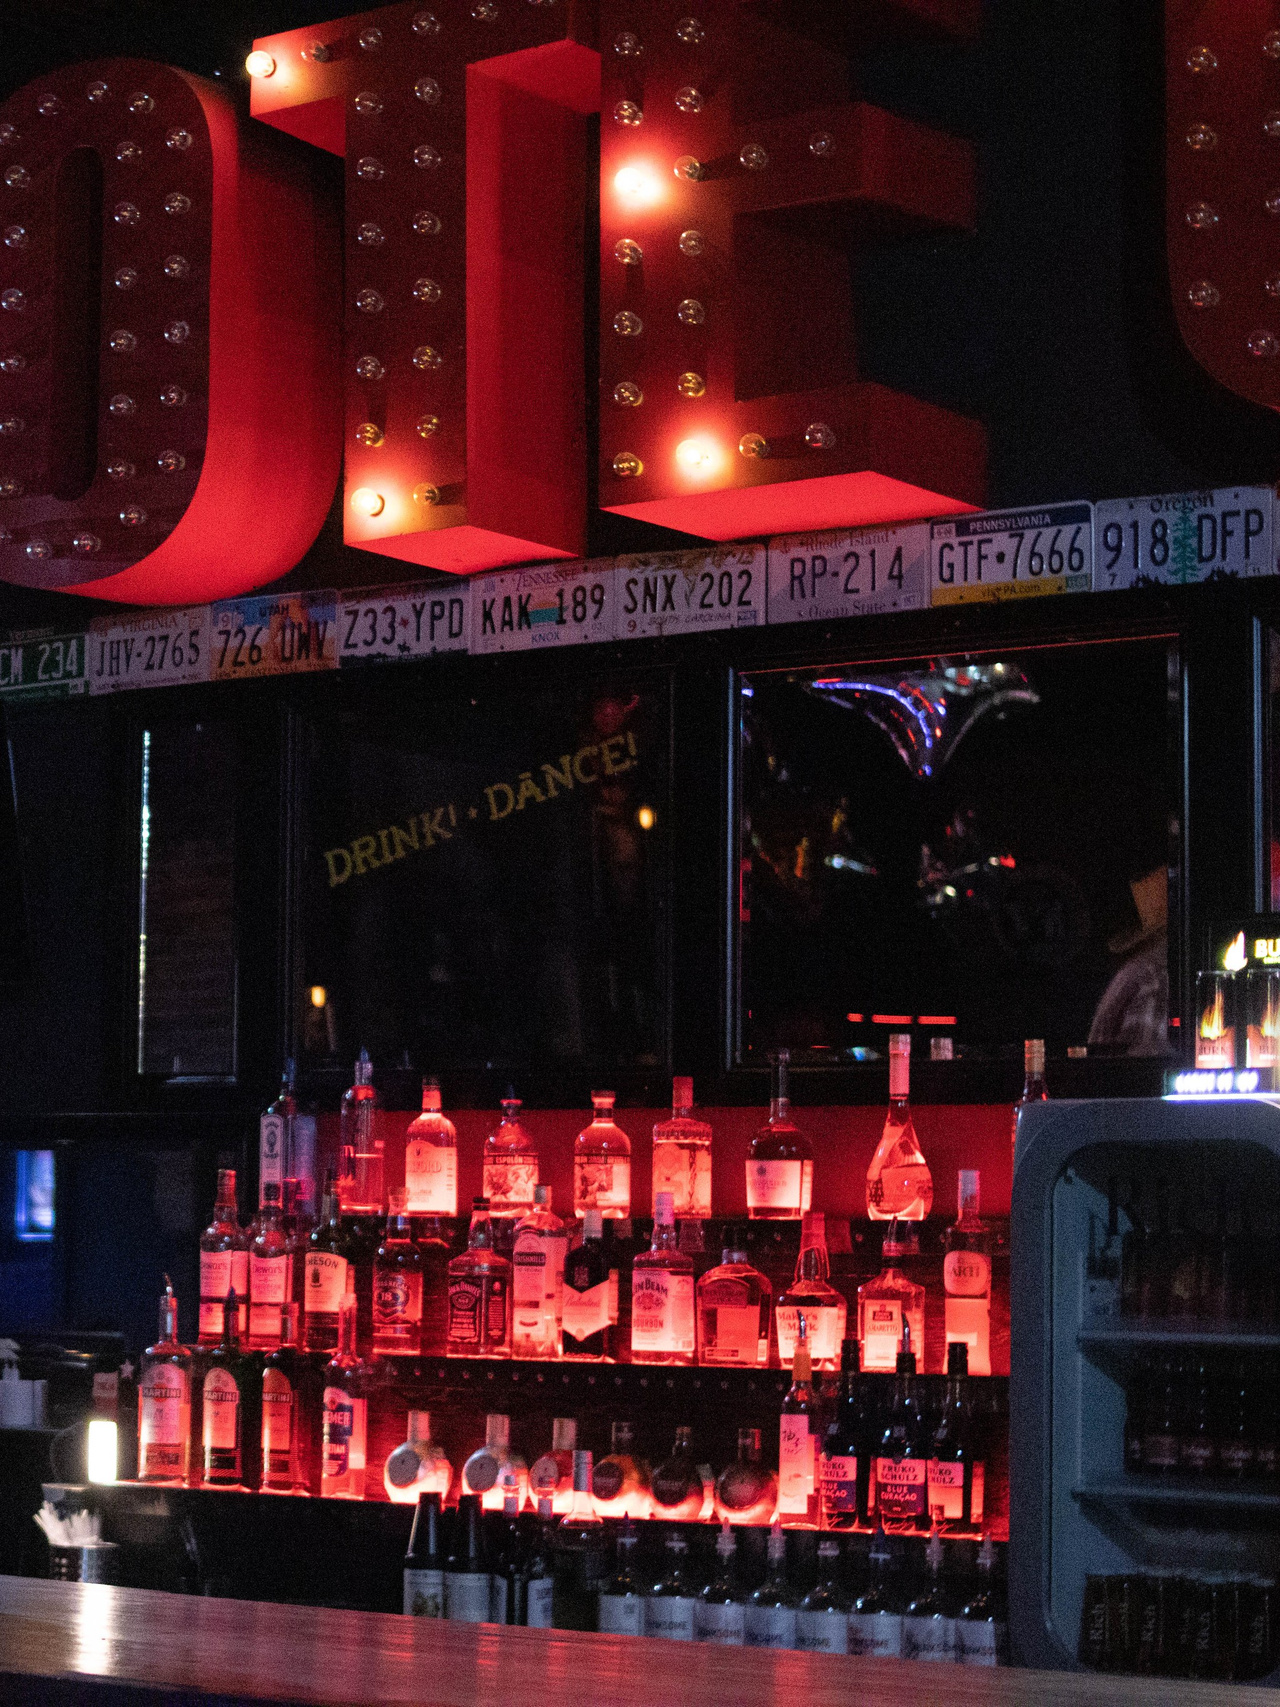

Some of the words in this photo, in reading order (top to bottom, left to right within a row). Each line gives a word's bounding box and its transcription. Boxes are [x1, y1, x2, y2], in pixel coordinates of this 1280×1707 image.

[850, 530, 889, 547] Island
[970, 513, 1051, 532] PENNSYLVANIA
[1103, 518, 1169, 570] 918
[1197, 509, 1264, 563] DFP
[624, 574, 676, 614] SNX
[700, 569, 751, 609] 202
[790, 546, 903, 600] RP-214
[121, 615, 178, 633] VIRGINIA
[482, 593, 532, 635] KAK
[556, 583, 605, 624] 189
[219, 626, 262, 668] 726
[531, 631, 560, 645] KNOX
[37, 639, 78, 680] 234
[324, 802, 458, 888] DRINK!
[483, 731, 639, 821] DANCE!
[1254, 939, 1280, 959] BU
[143, 1387, 181, 1398] MARTINI
